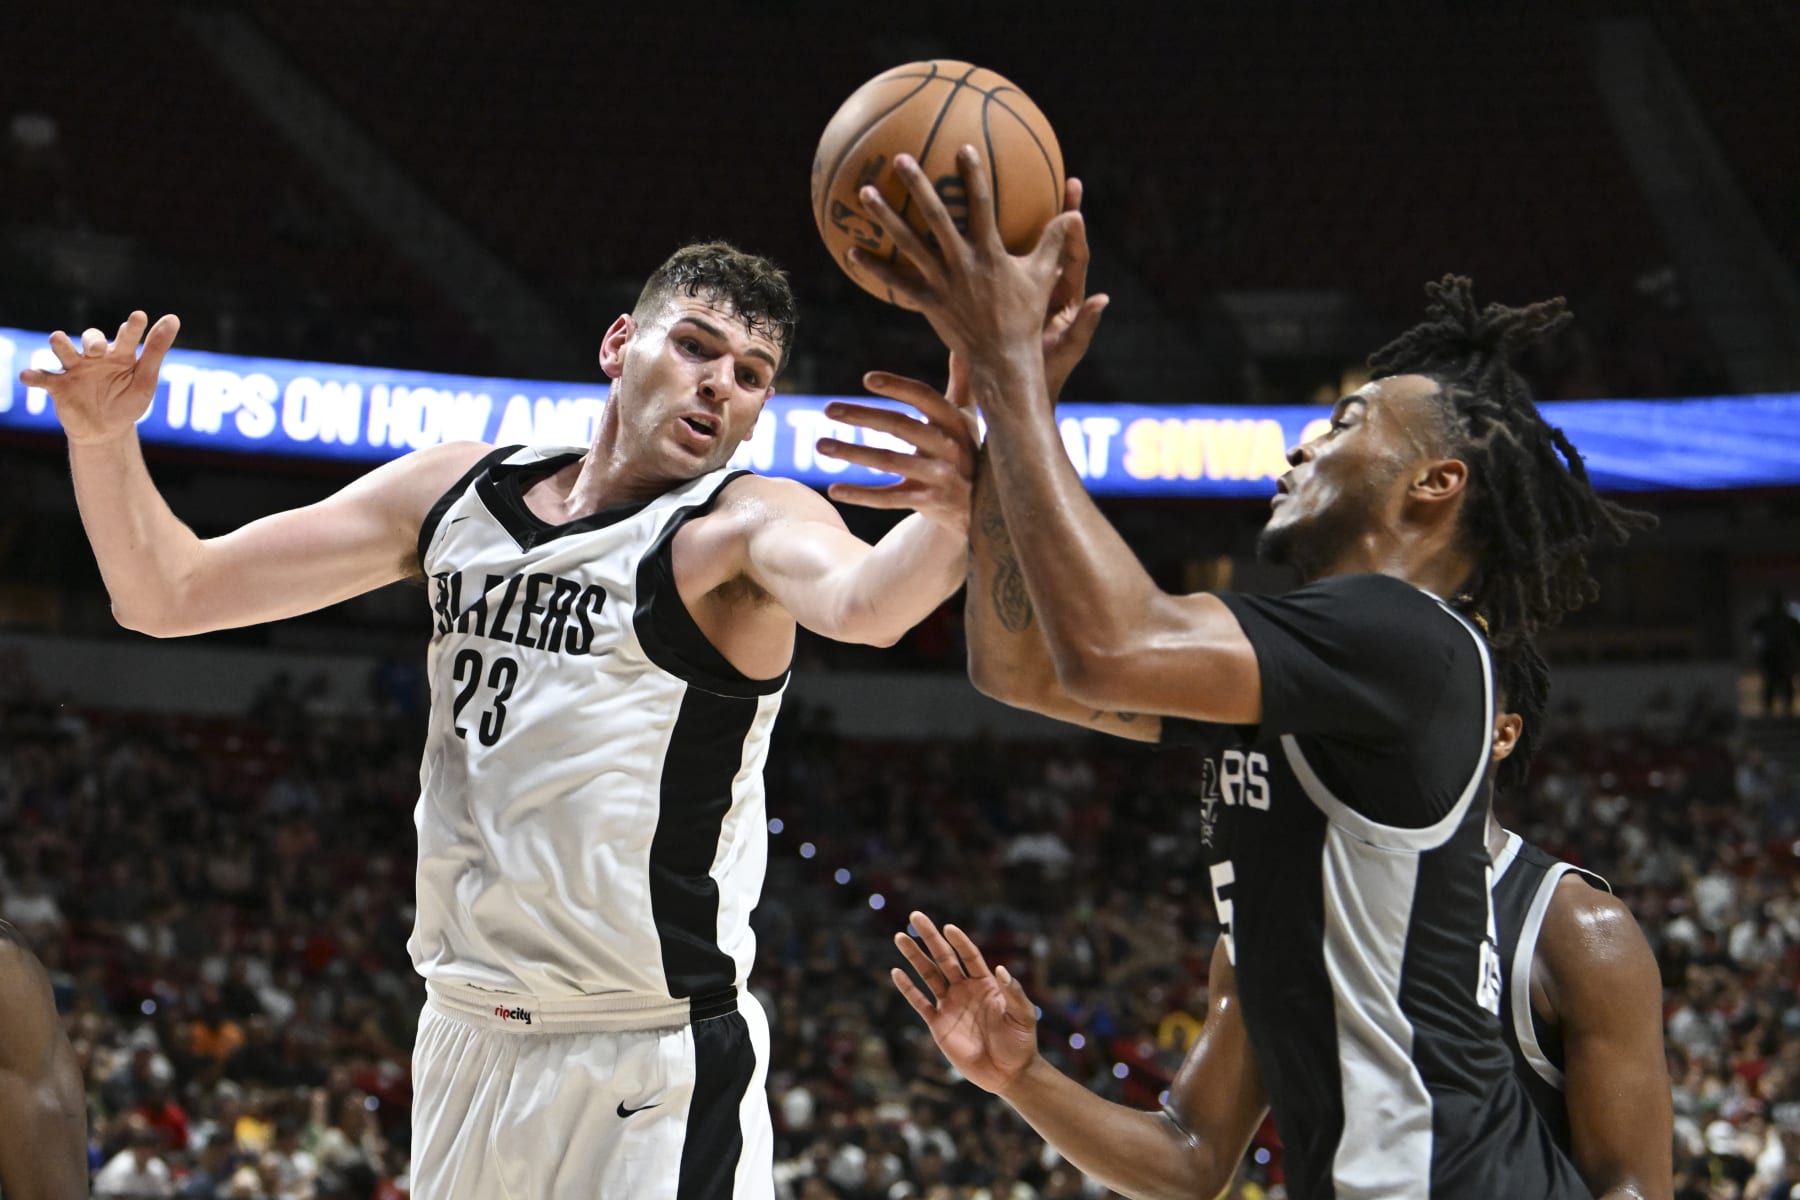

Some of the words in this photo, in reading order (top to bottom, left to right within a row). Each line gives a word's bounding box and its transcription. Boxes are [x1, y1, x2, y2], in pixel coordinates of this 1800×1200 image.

[161, 364, 279, 438] TIPS
[282, 376, 362, 445] ON
[367, 384, 492, 450] HOW
[493, 394, 607, 447] AND
[453, 648, 519, 747] 23
